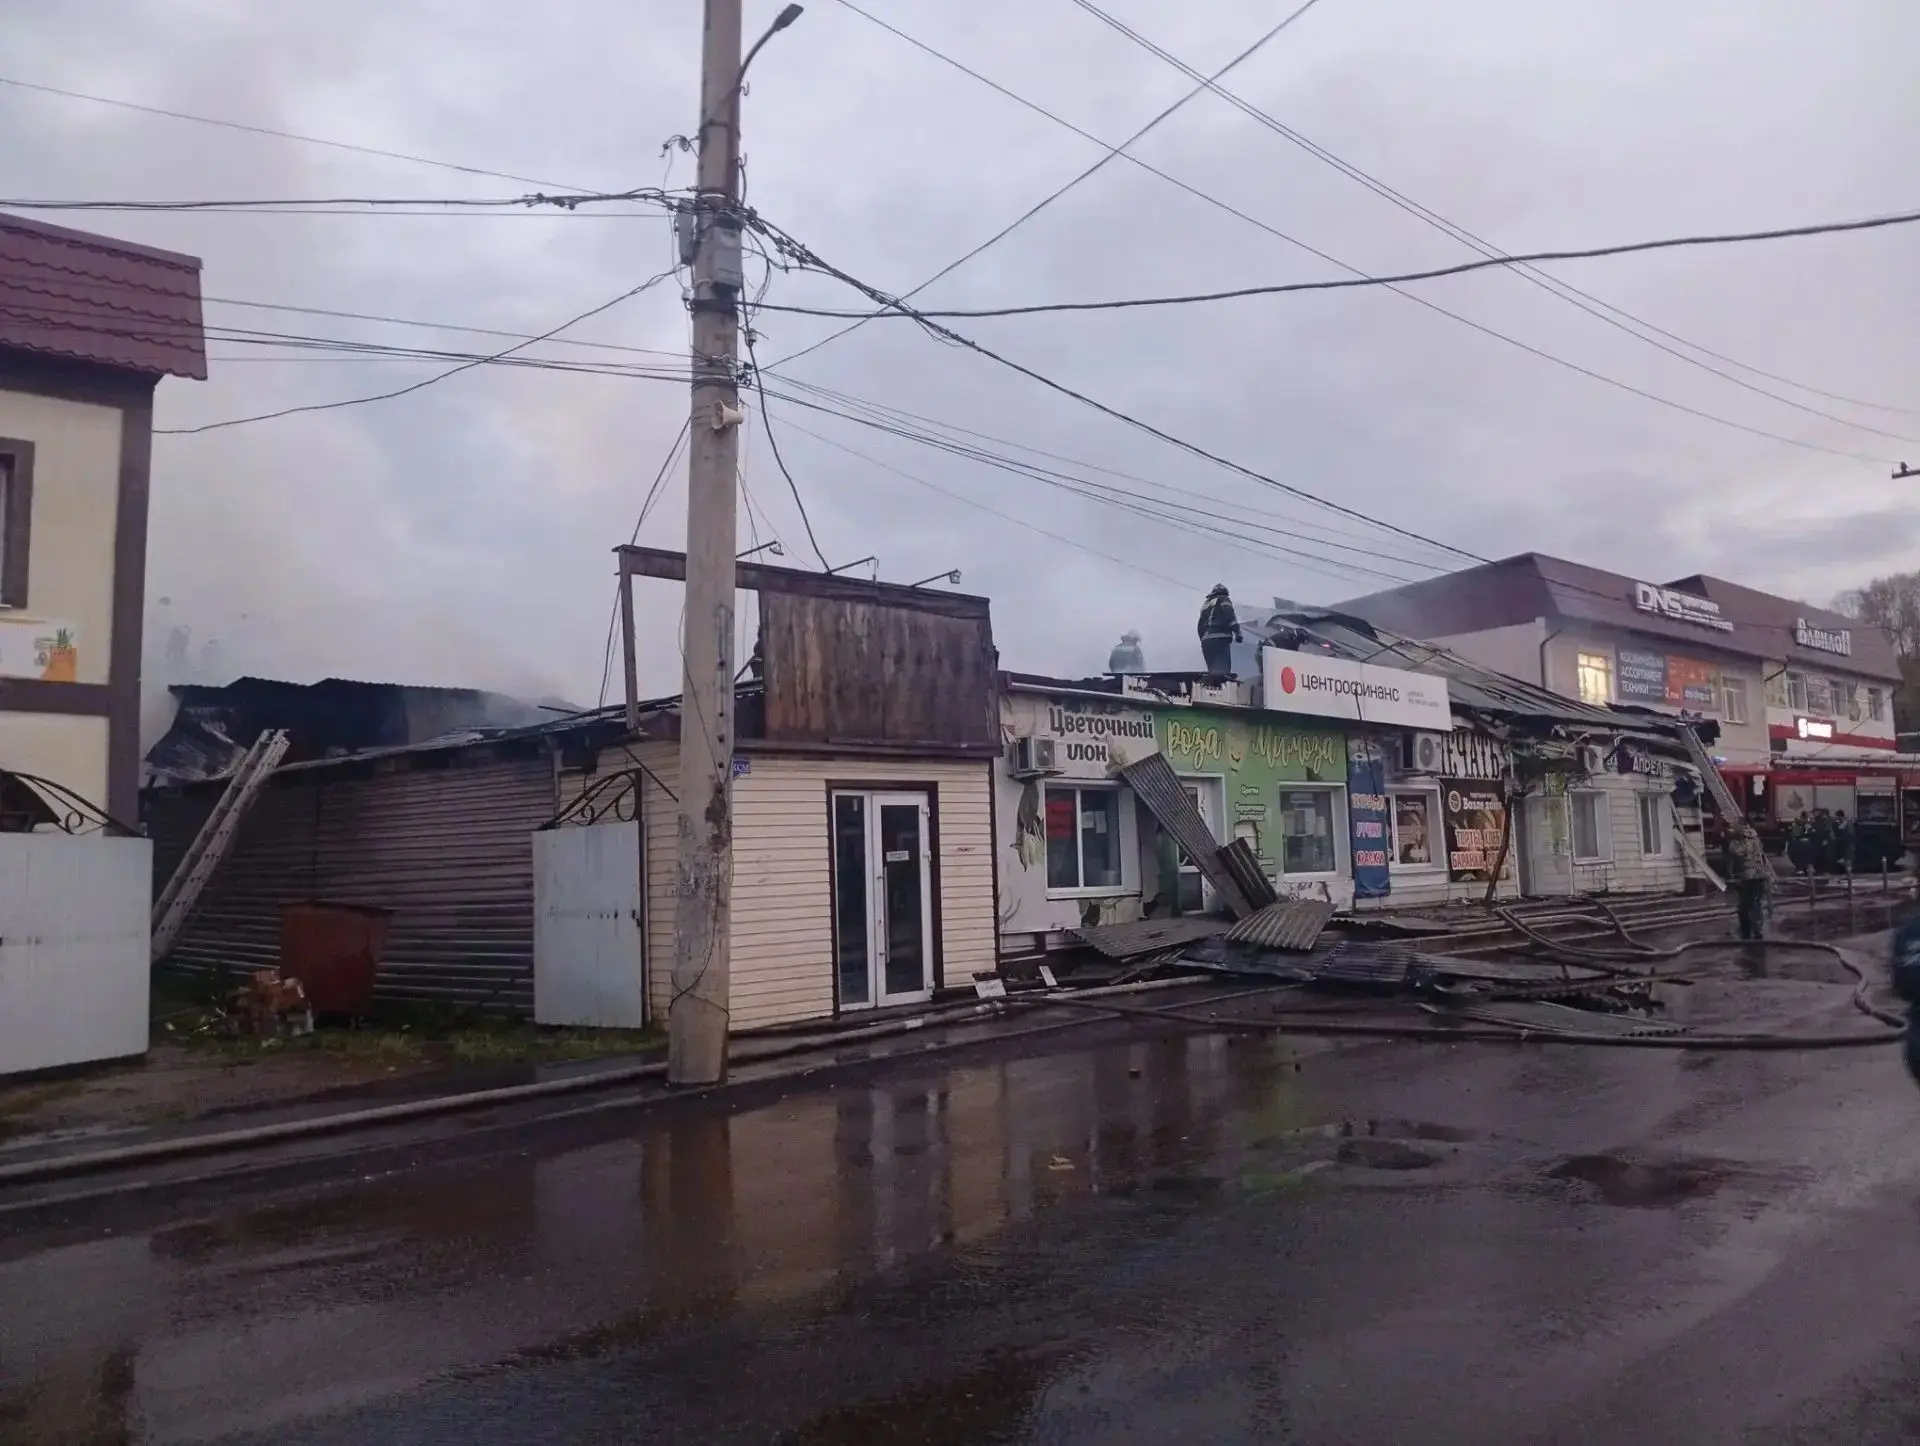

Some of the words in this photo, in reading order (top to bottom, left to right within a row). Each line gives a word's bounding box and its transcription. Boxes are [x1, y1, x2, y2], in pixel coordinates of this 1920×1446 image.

[1636, 582, 1682, 614] DNS
[1301, 674, 1400, 702] центрофинанс
[1048, 706, 1154, 739] Цветочный
[1167, 719, 1221, 770] Роза
[1253, 724, 1338, 775] Мимоза
[1462, 797, 1484, 810] Возле
